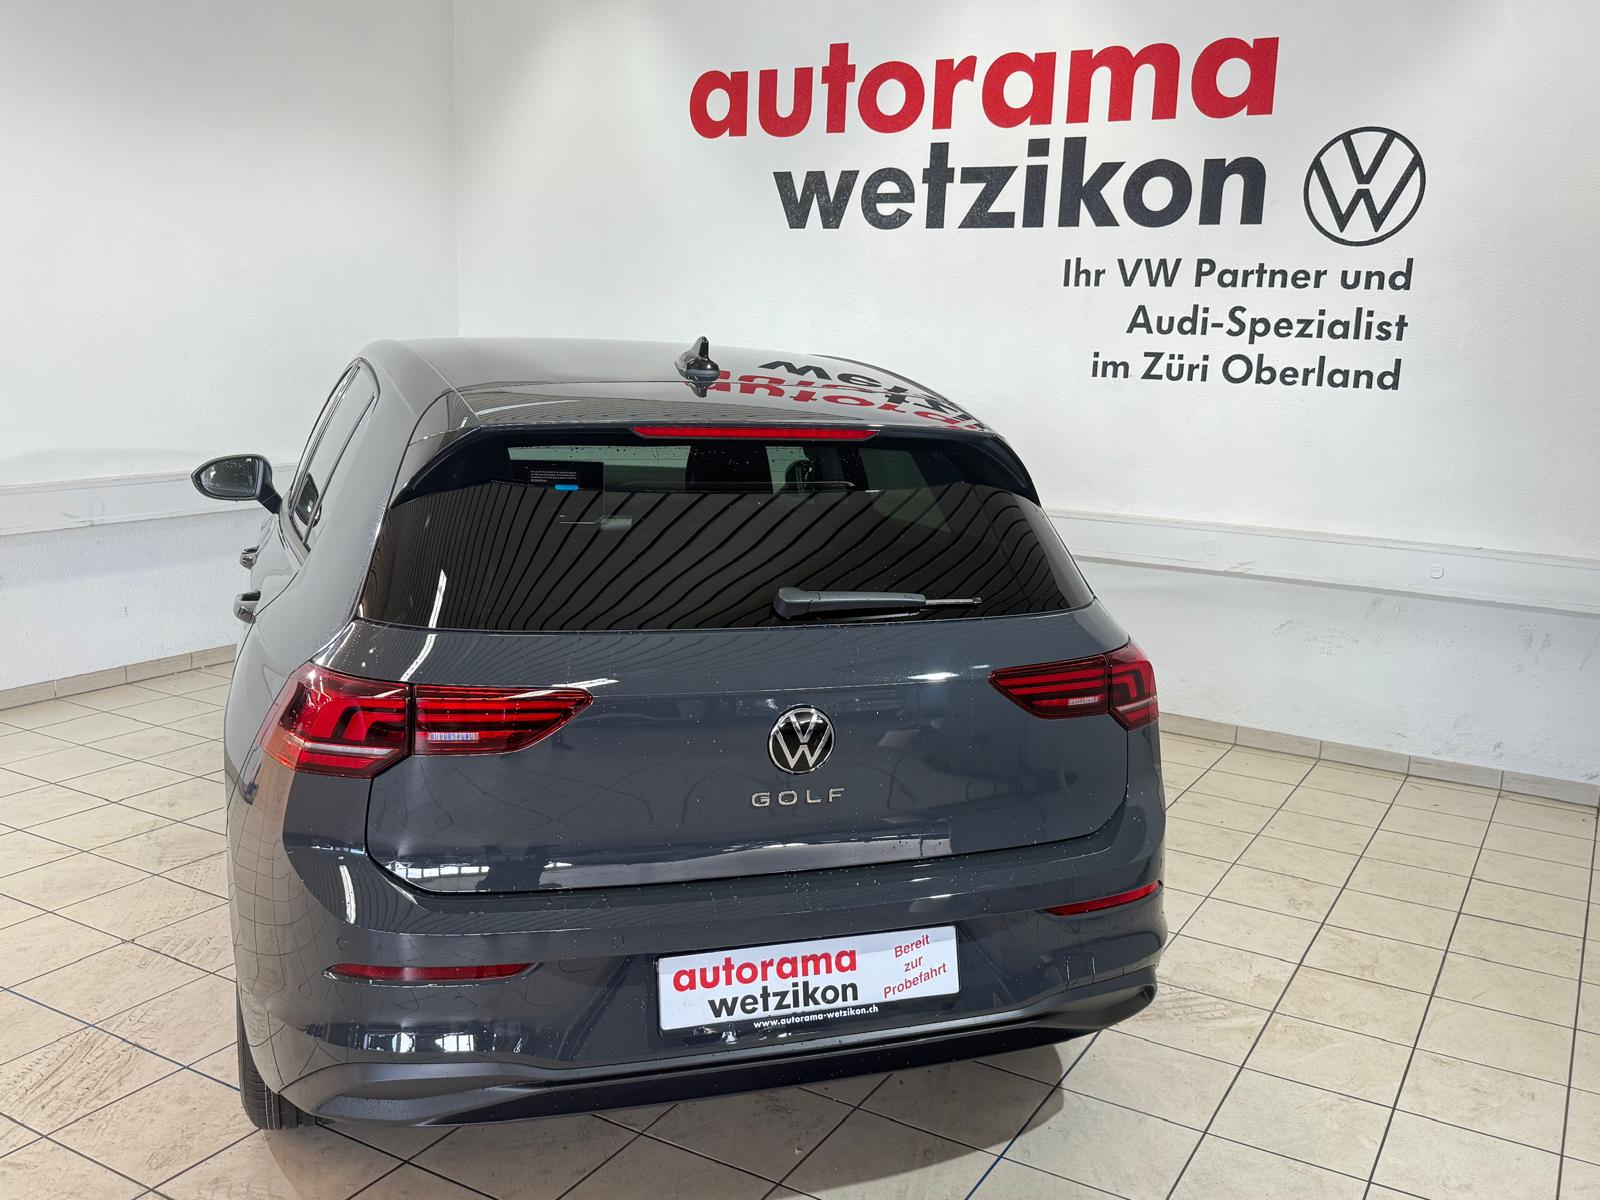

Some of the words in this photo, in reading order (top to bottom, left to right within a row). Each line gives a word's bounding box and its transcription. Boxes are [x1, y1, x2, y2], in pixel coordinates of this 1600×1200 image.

[689, 36, 1280, 139] autorama
[773, 136, 1268, 230] wetzikon
[1063, 257, 1106, 288] Ihr
[1116, 258, 1183, 288] VW
[1194, 257, 1328, 290] Partner
[1340, 257, 1414, 292] und
[1125, 303, 1409, 345] Audi-Spezialist
[1091, 352, 1130, 379] im
[1140, 351, 1210, 382] Züri
[1221, 353, 1402, 391] Oberland
[751, 786, 845, 808] GOLF
[894, 933, 930, 959] Bereit
[904, 955, 924, 973] zur
[672, 949, 857, 993] autorama
[883, 962, 947, 999] Probefahrt
[707, 980, 859, 1019] wetzikon
[753, 1003, 879, 1029] www.autorama-wetzikon.ch
